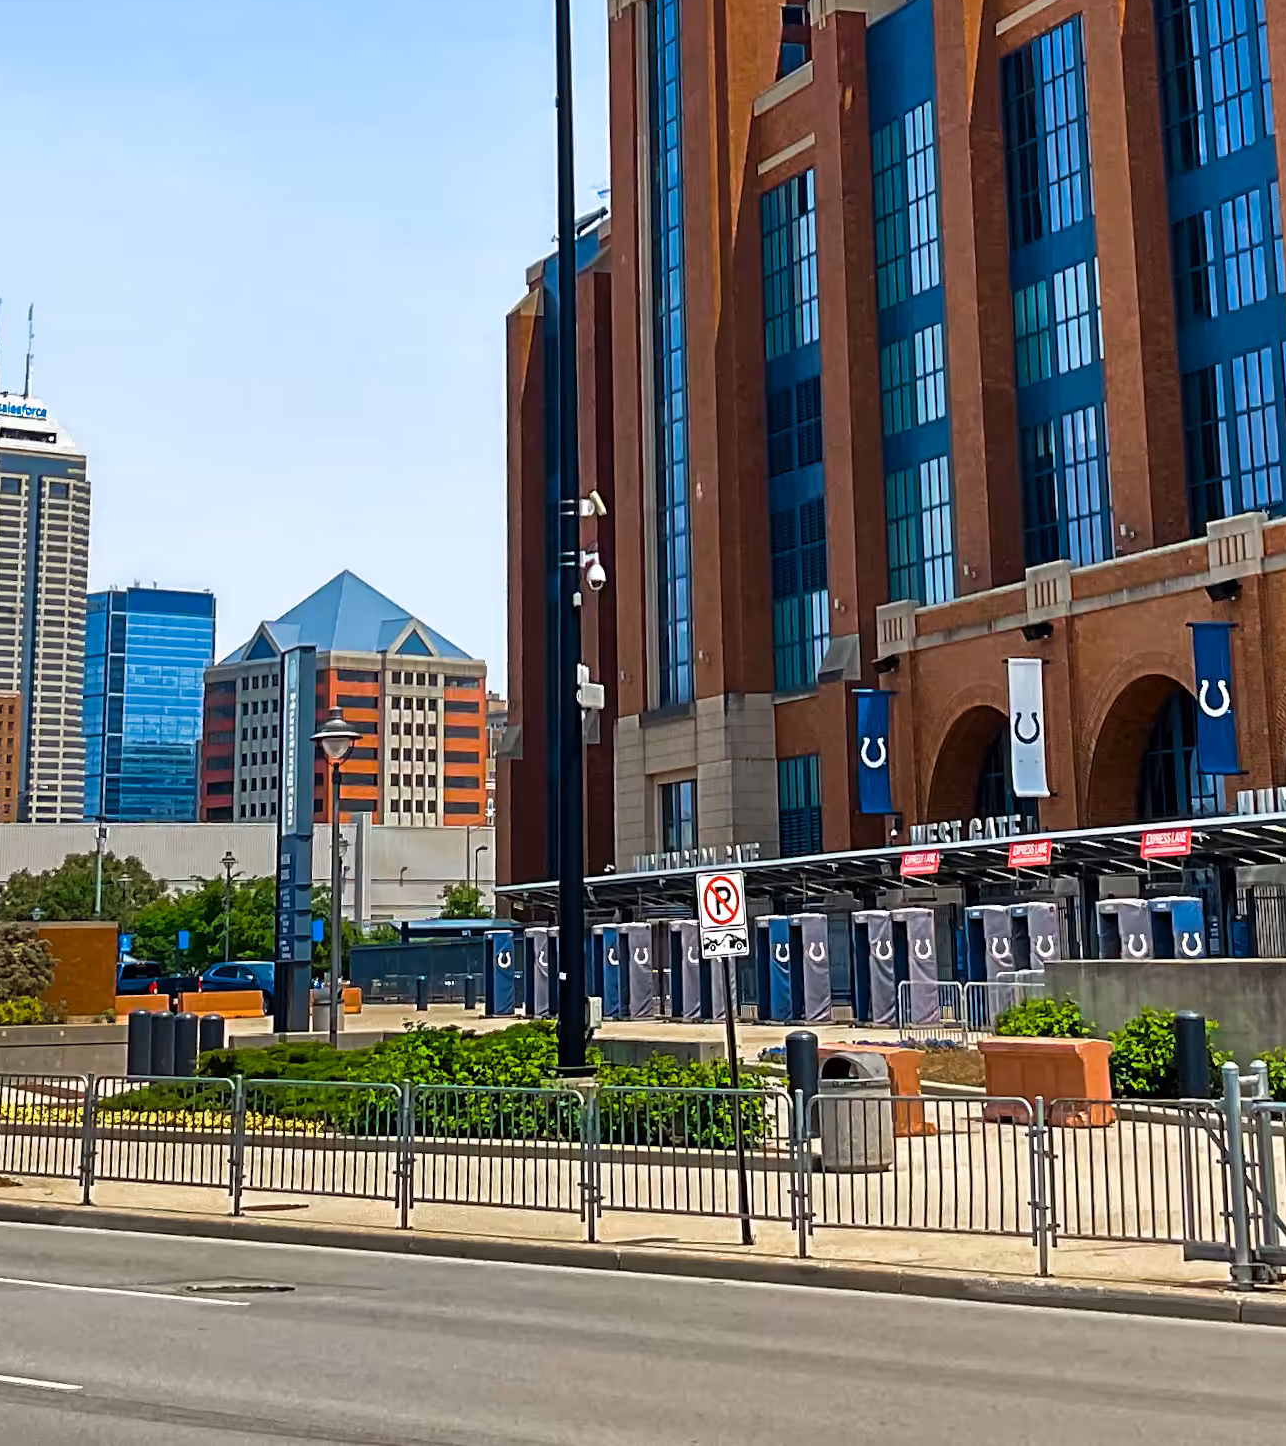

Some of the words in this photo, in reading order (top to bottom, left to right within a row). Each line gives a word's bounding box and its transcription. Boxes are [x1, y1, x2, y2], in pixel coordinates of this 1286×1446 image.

[910, 819, 962, 846] WEST
[969, 814, 1022, 841] GATE
[715, 886, 731, 915] P
